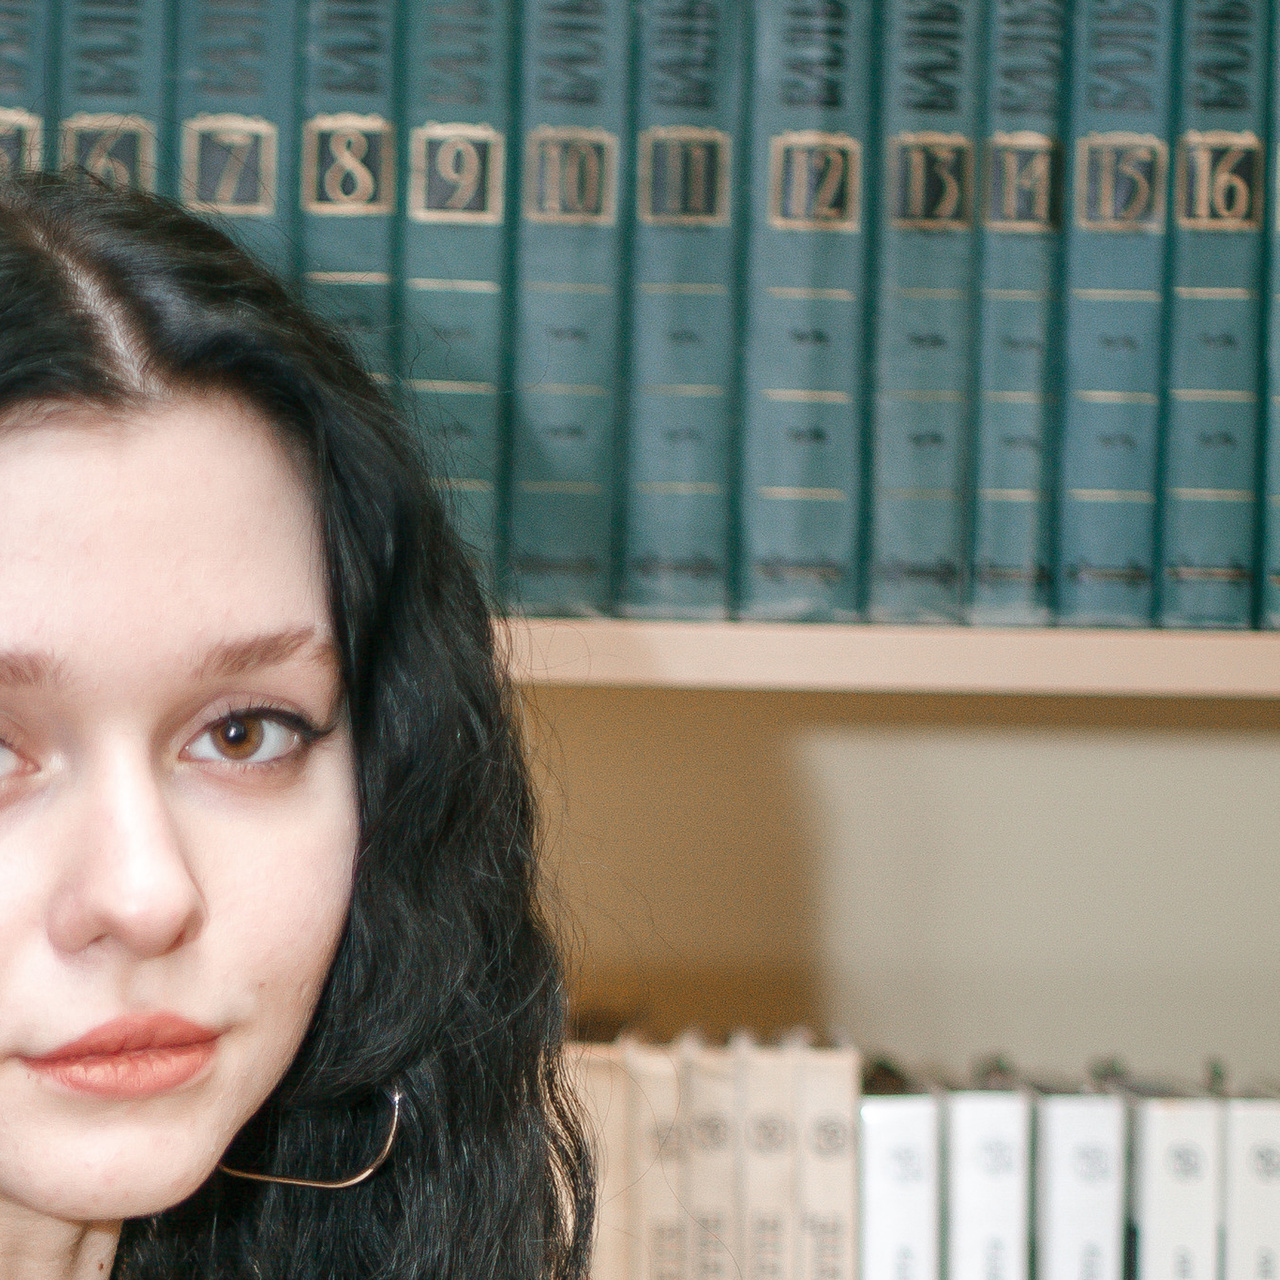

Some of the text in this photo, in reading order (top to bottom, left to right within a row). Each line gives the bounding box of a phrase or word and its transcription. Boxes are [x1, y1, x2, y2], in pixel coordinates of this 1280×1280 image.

[212, 131, 253, 203] 7
[325, 130, 373, 203] 8
[436, 139, 480, 208] 9
[544, 144, 601, 214] 10
[666, 142, 708, 213] 11
[792, 150, 844, 218] 12
[910, 148, 959, 217] 13
[1004, 152, 1050, 218] 14
[1101, 149, 1150, 218] 15
[1194, 149, 1250, 218] 16
